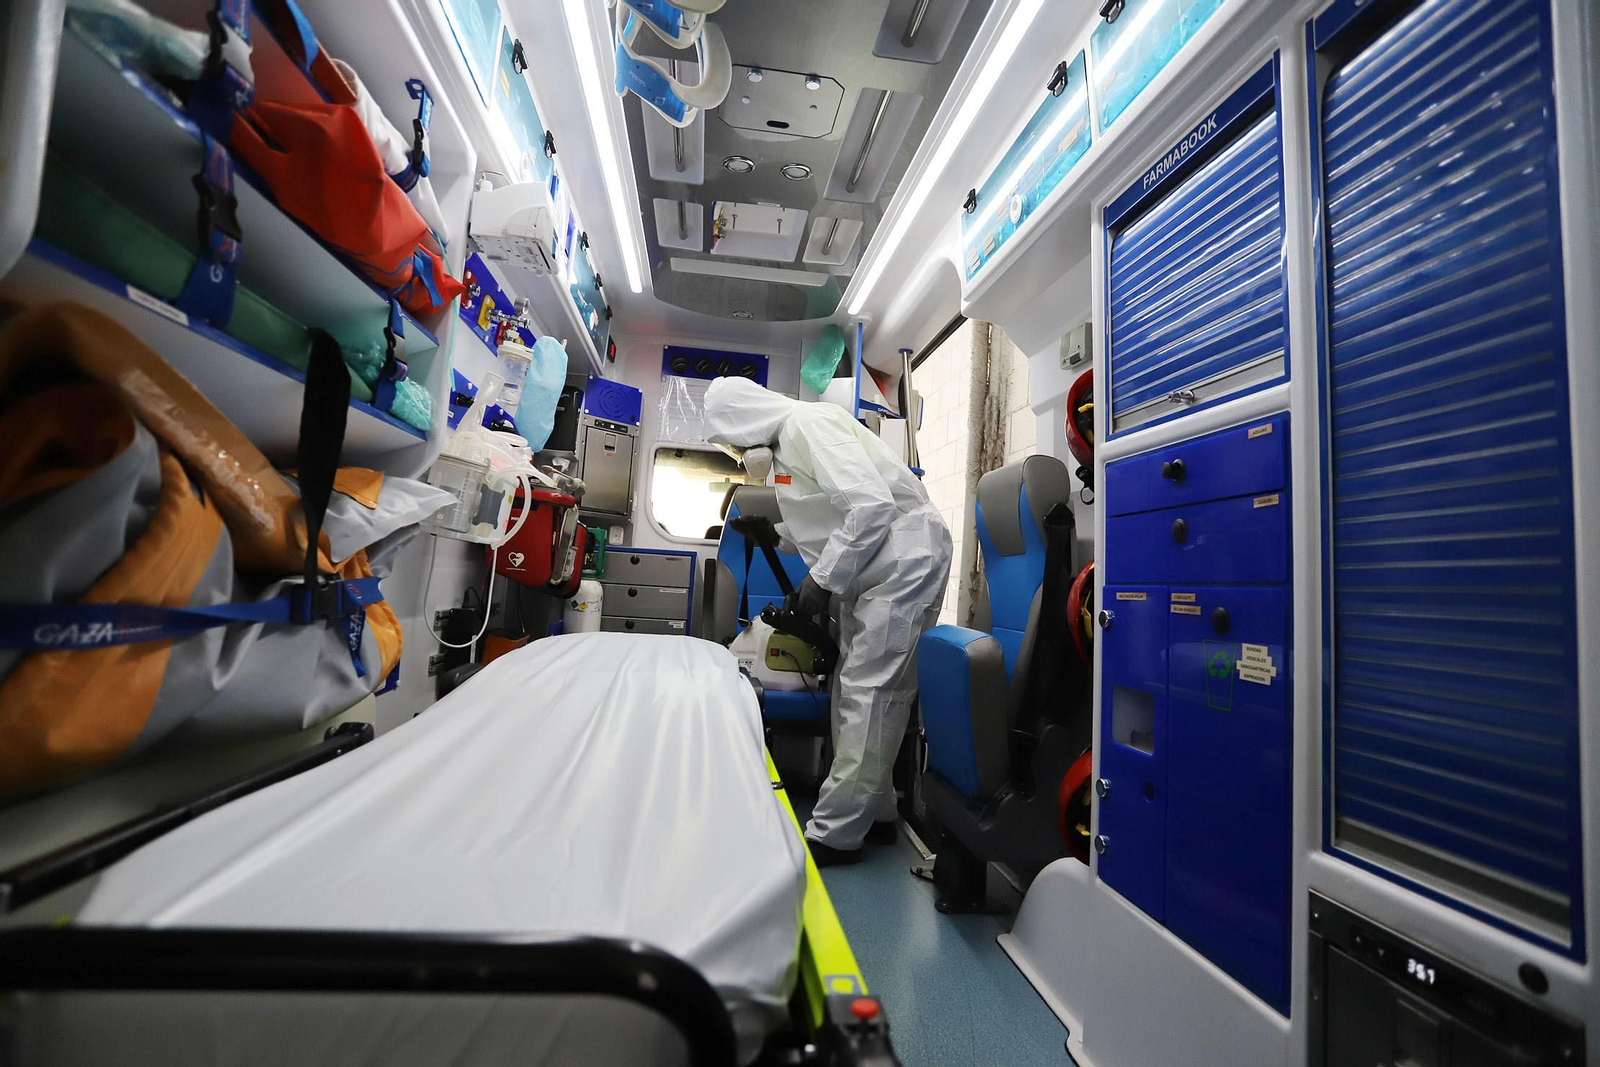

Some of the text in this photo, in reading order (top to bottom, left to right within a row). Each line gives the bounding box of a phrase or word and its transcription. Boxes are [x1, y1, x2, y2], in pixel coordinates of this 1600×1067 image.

[1143, 113, 1217, 190] FARMABOOK
[33, 622, 113, 644] GAZA
[349, 614, 362, 651] GAZA
